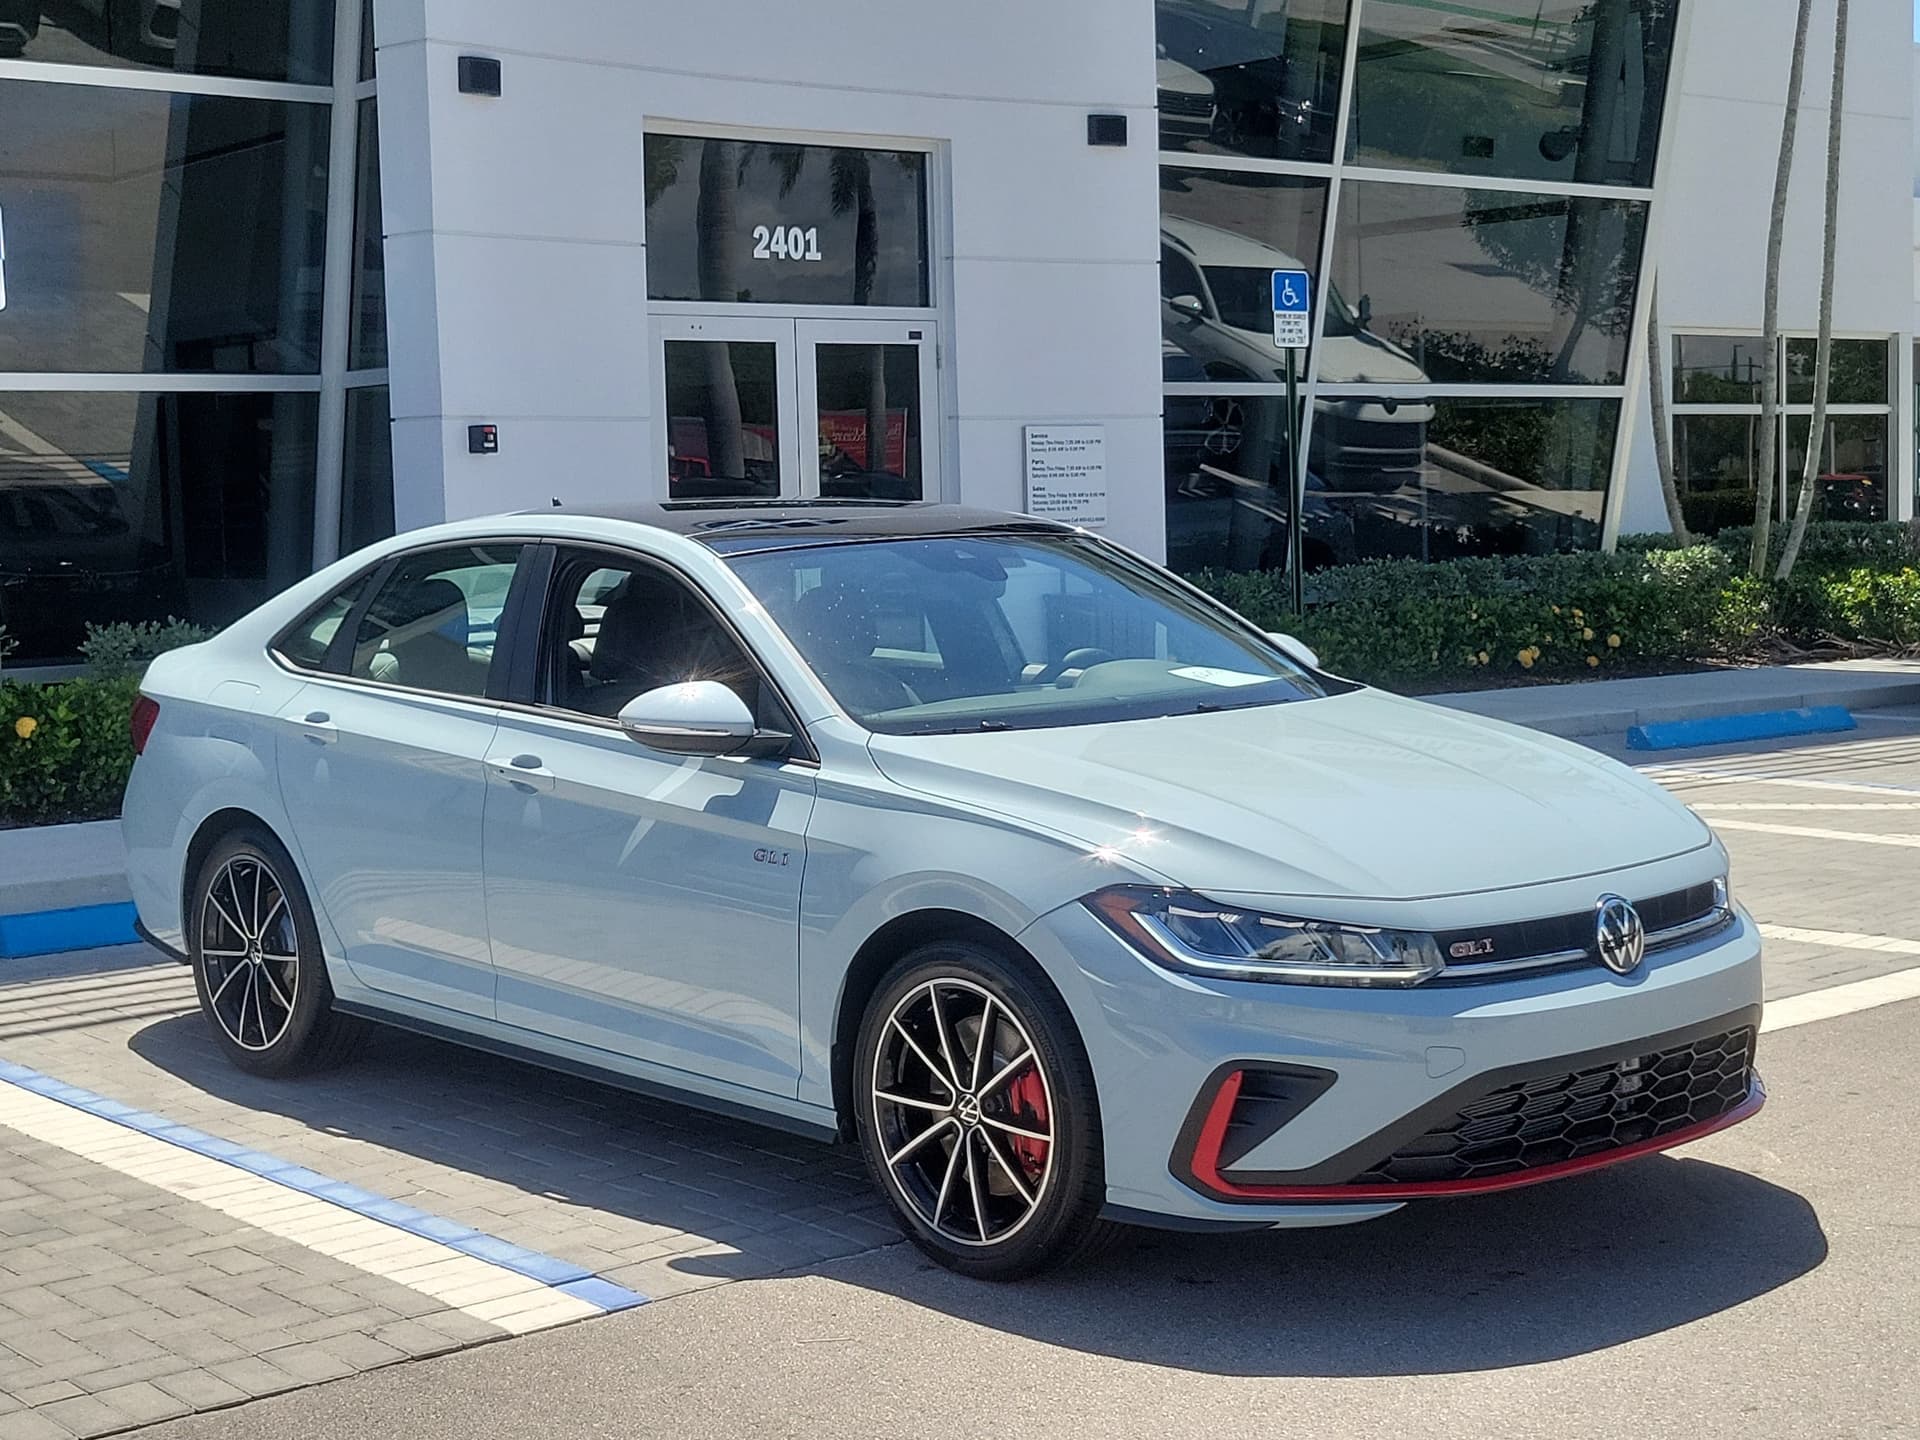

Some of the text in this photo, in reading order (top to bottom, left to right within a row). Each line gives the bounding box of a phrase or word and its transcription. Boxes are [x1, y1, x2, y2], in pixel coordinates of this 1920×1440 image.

[752, 225, 822, 261] 2401
[753, 848, 788, 866] GLI
[1450, 938, 1493, 958] GLI
